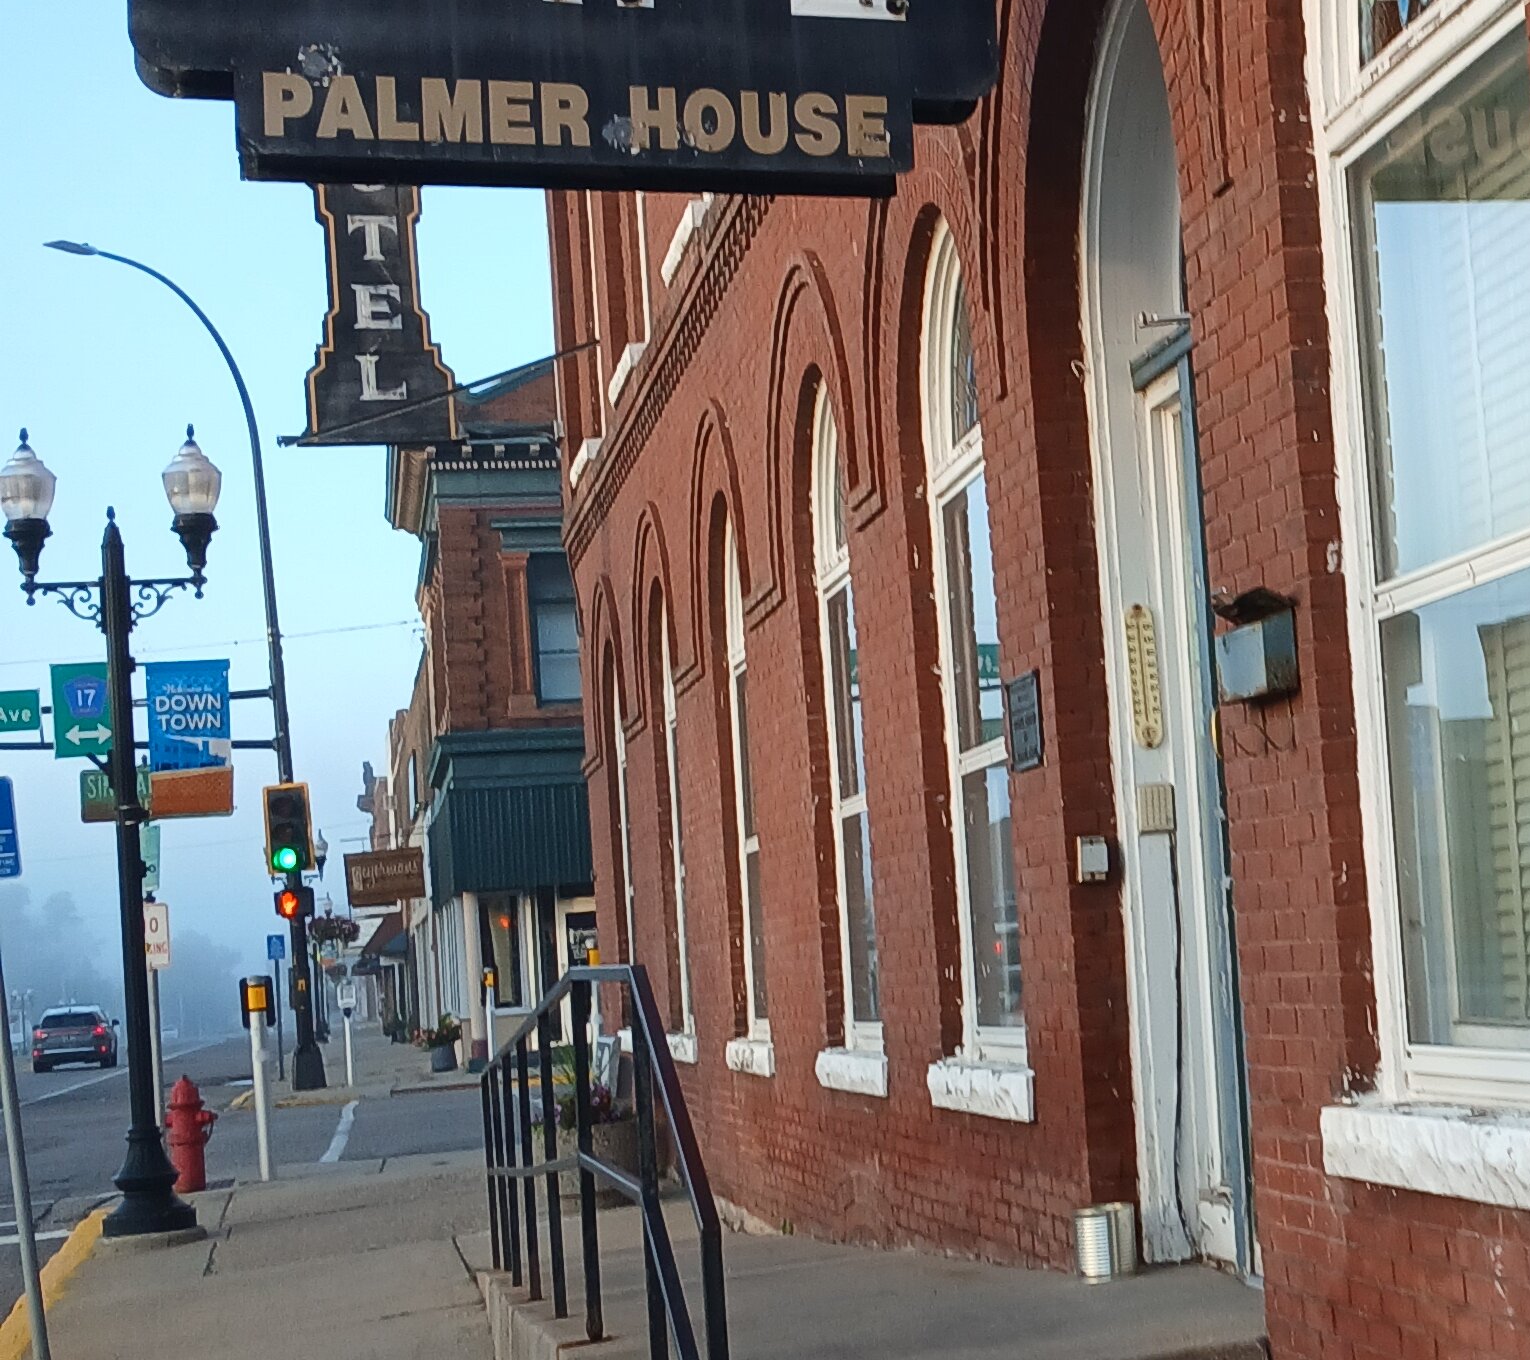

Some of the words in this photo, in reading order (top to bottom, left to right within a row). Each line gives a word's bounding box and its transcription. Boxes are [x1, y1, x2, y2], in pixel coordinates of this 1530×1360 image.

[262, 71, 590, 147] PALMER
[629, 85, 890, 158] HOUSE
[345, 184, 408, 401] TEL
[77, 689, 96, 707] 17
[155, 692, 222, 713] DOWN
[0, 707, 31, 723] Ave
[157, 711, 221, 732] TOWN
